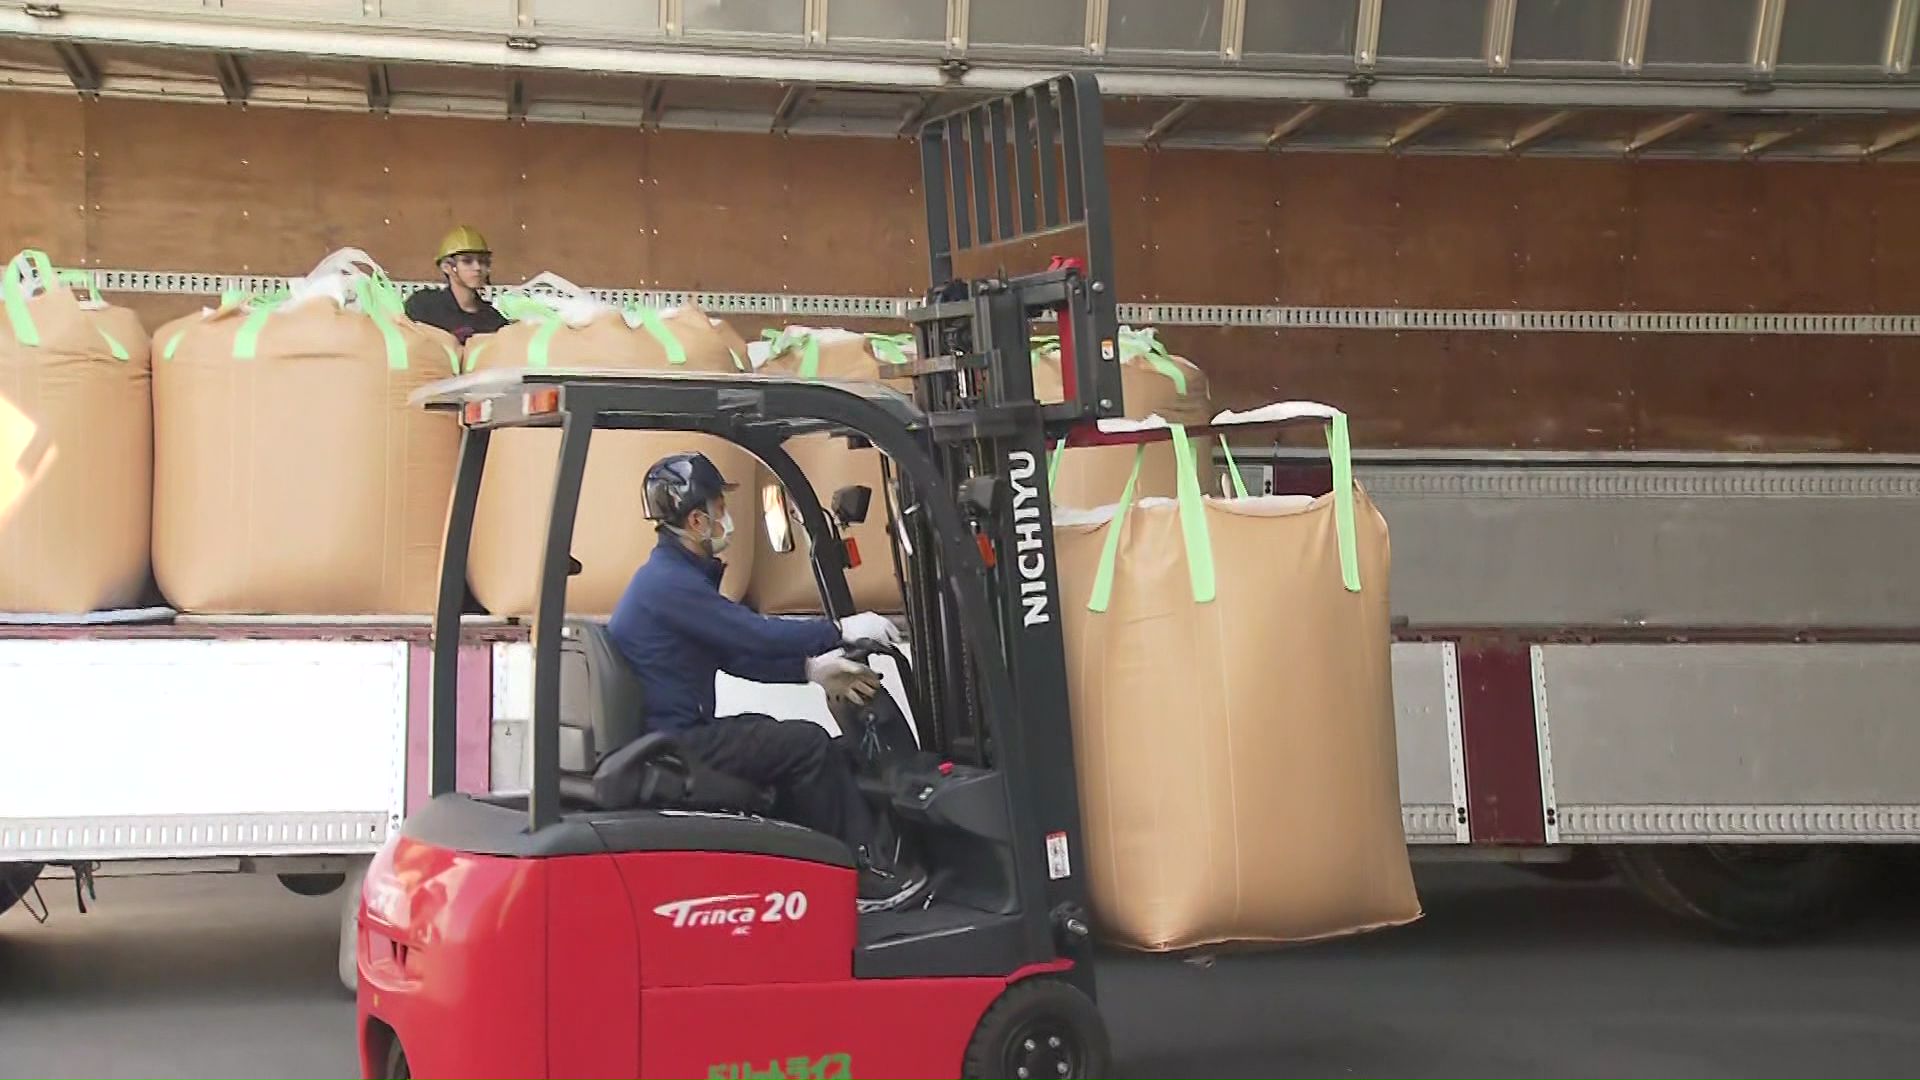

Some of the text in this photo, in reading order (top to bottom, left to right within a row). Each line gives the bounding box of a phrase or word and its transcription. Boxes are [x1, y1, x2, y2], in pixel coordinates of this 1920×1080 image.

[1008, 450, 1050, 627] NICHIYU
[653, 890, 808, 928] Trinca 20
